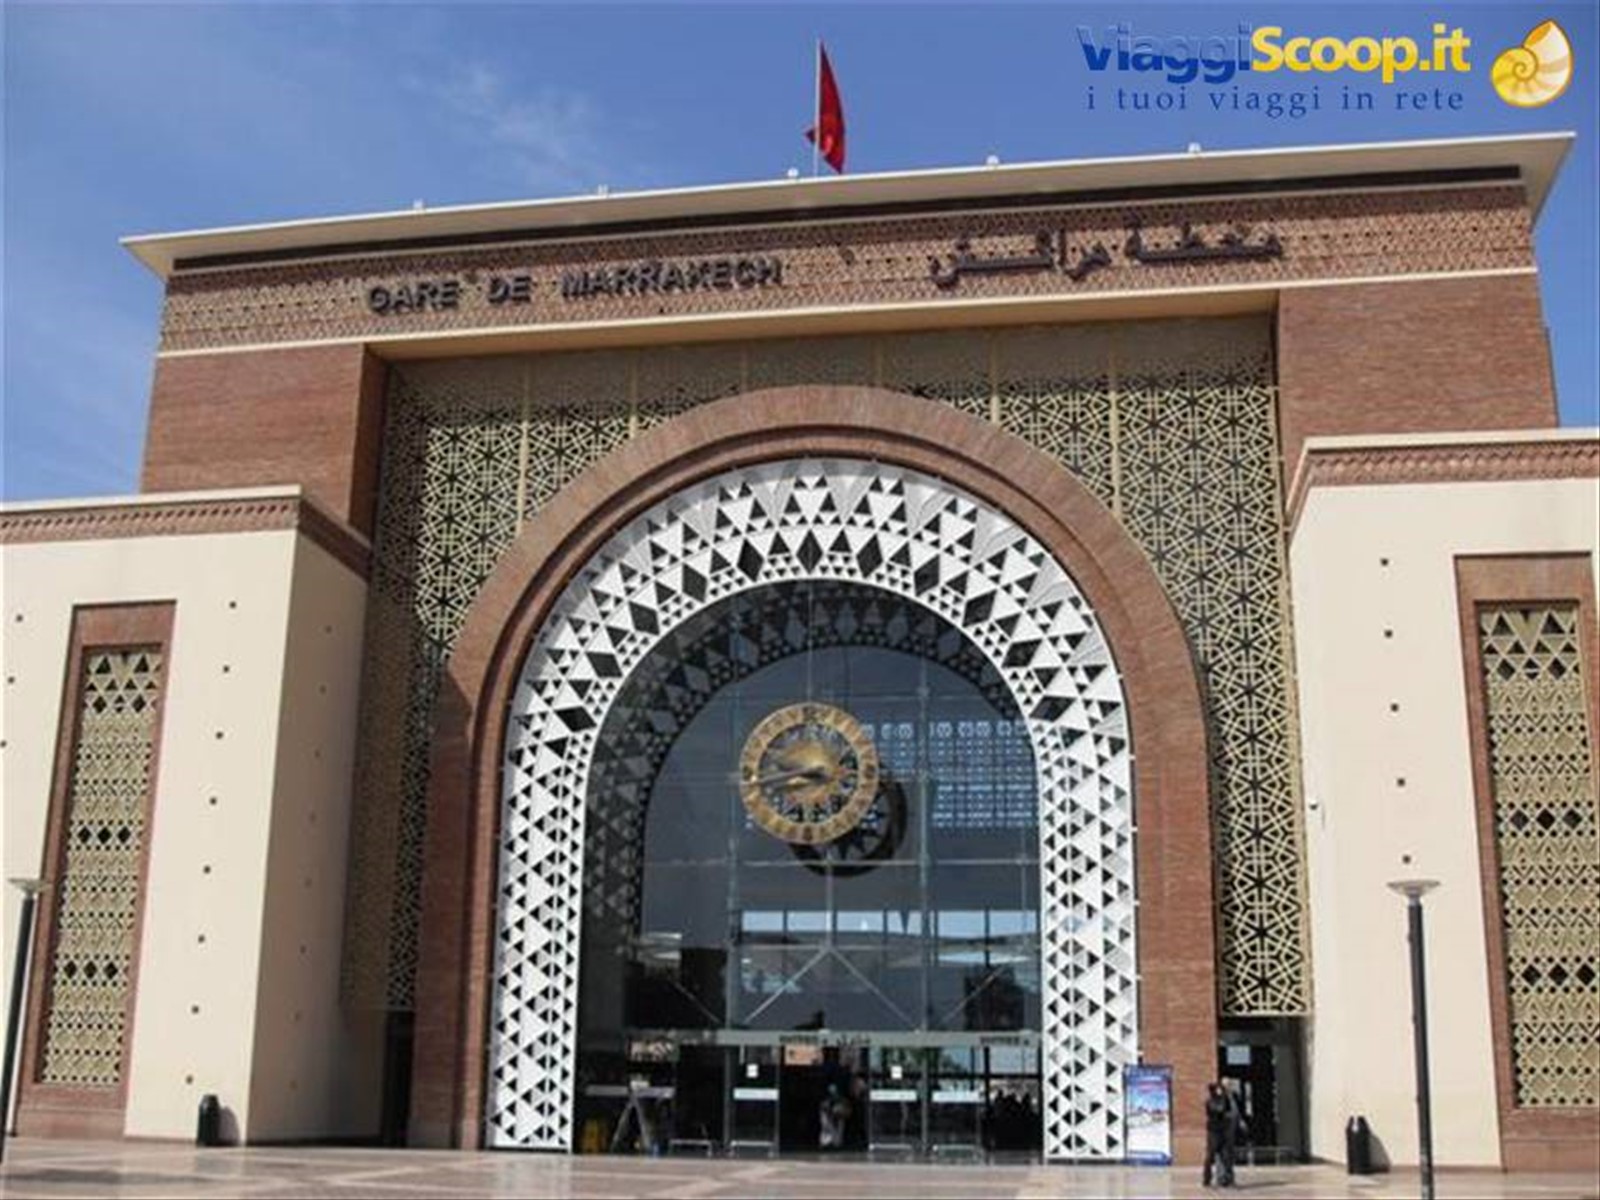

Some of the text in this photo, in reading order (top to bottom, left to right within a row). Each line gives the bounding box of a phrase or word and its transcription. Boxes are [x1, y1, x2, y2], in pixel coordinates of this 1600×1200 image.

[931, 214, 1283, 288] محطة مراكش
[369, 257, 783, 315] GARE DE MARRAKECH
